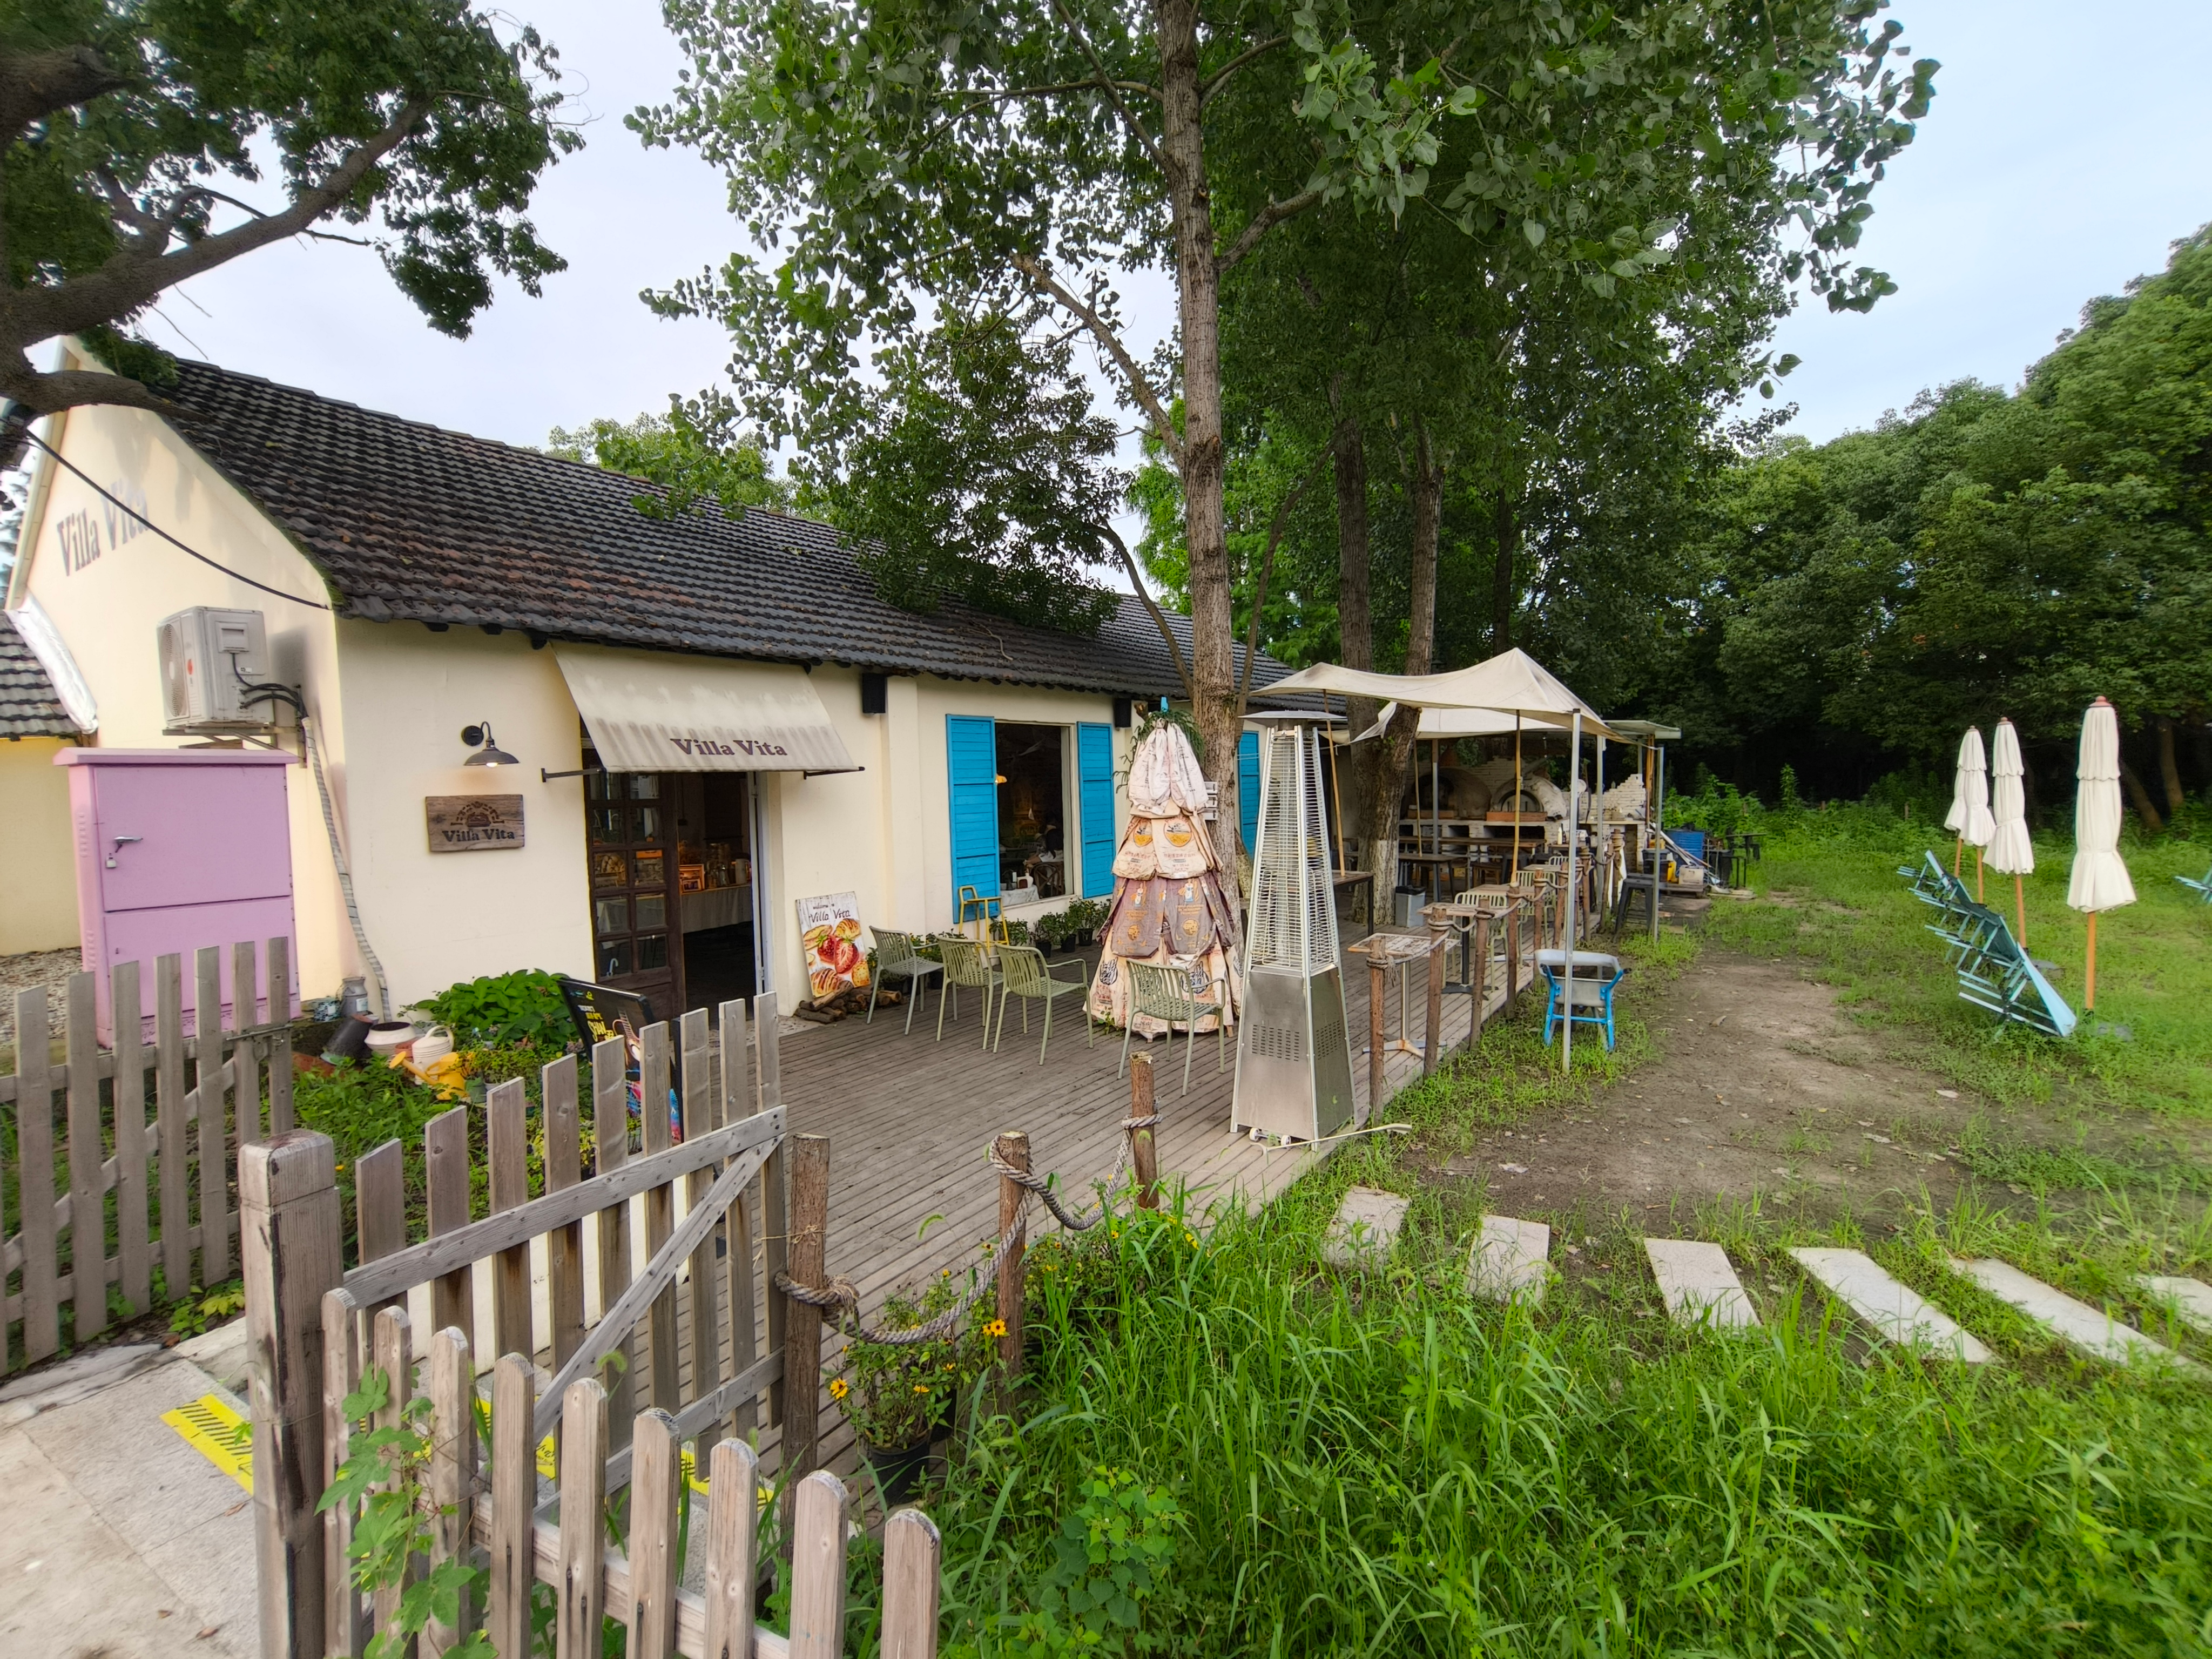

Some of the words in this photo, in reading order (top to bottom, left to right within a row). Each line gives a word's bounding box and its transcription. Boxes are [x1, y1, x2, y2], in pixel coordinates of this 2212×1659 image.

[57, 508, 100, 577] Villa
[100, 478, 149, 551] Vita
[670, 738, 735, 755] Villa
[733, 740, 788, 756] Vita
[442, 829, 480, 842] Villa
[482, 829, 515, 840] Vita
[811, 912, 829, 922] Villa
